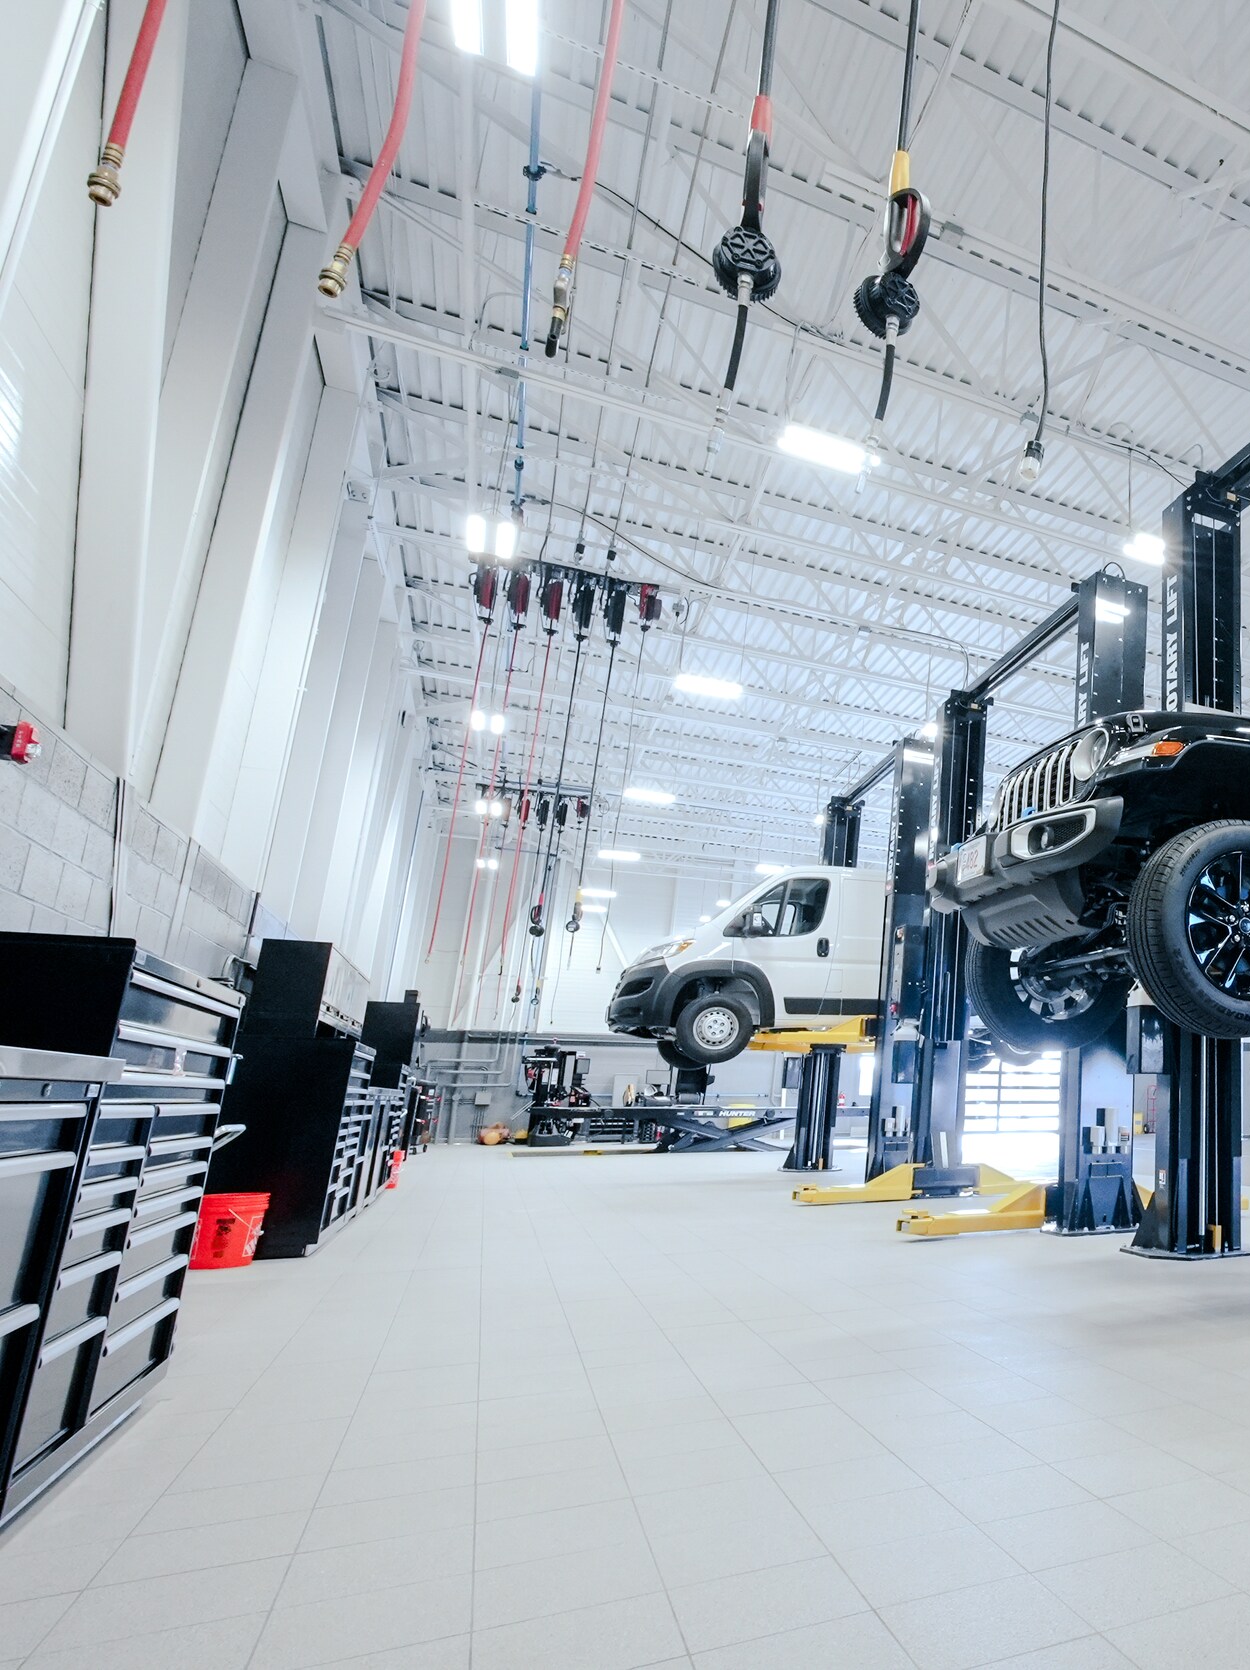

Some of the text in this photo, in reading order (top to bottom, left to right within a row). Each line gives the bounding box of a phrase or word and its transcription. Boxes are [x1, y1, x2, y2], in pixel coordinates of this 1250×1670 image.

[1079, 642, 1090, 686] LIFT
[1166, 575, 1178, 712] OTARY LIFT
